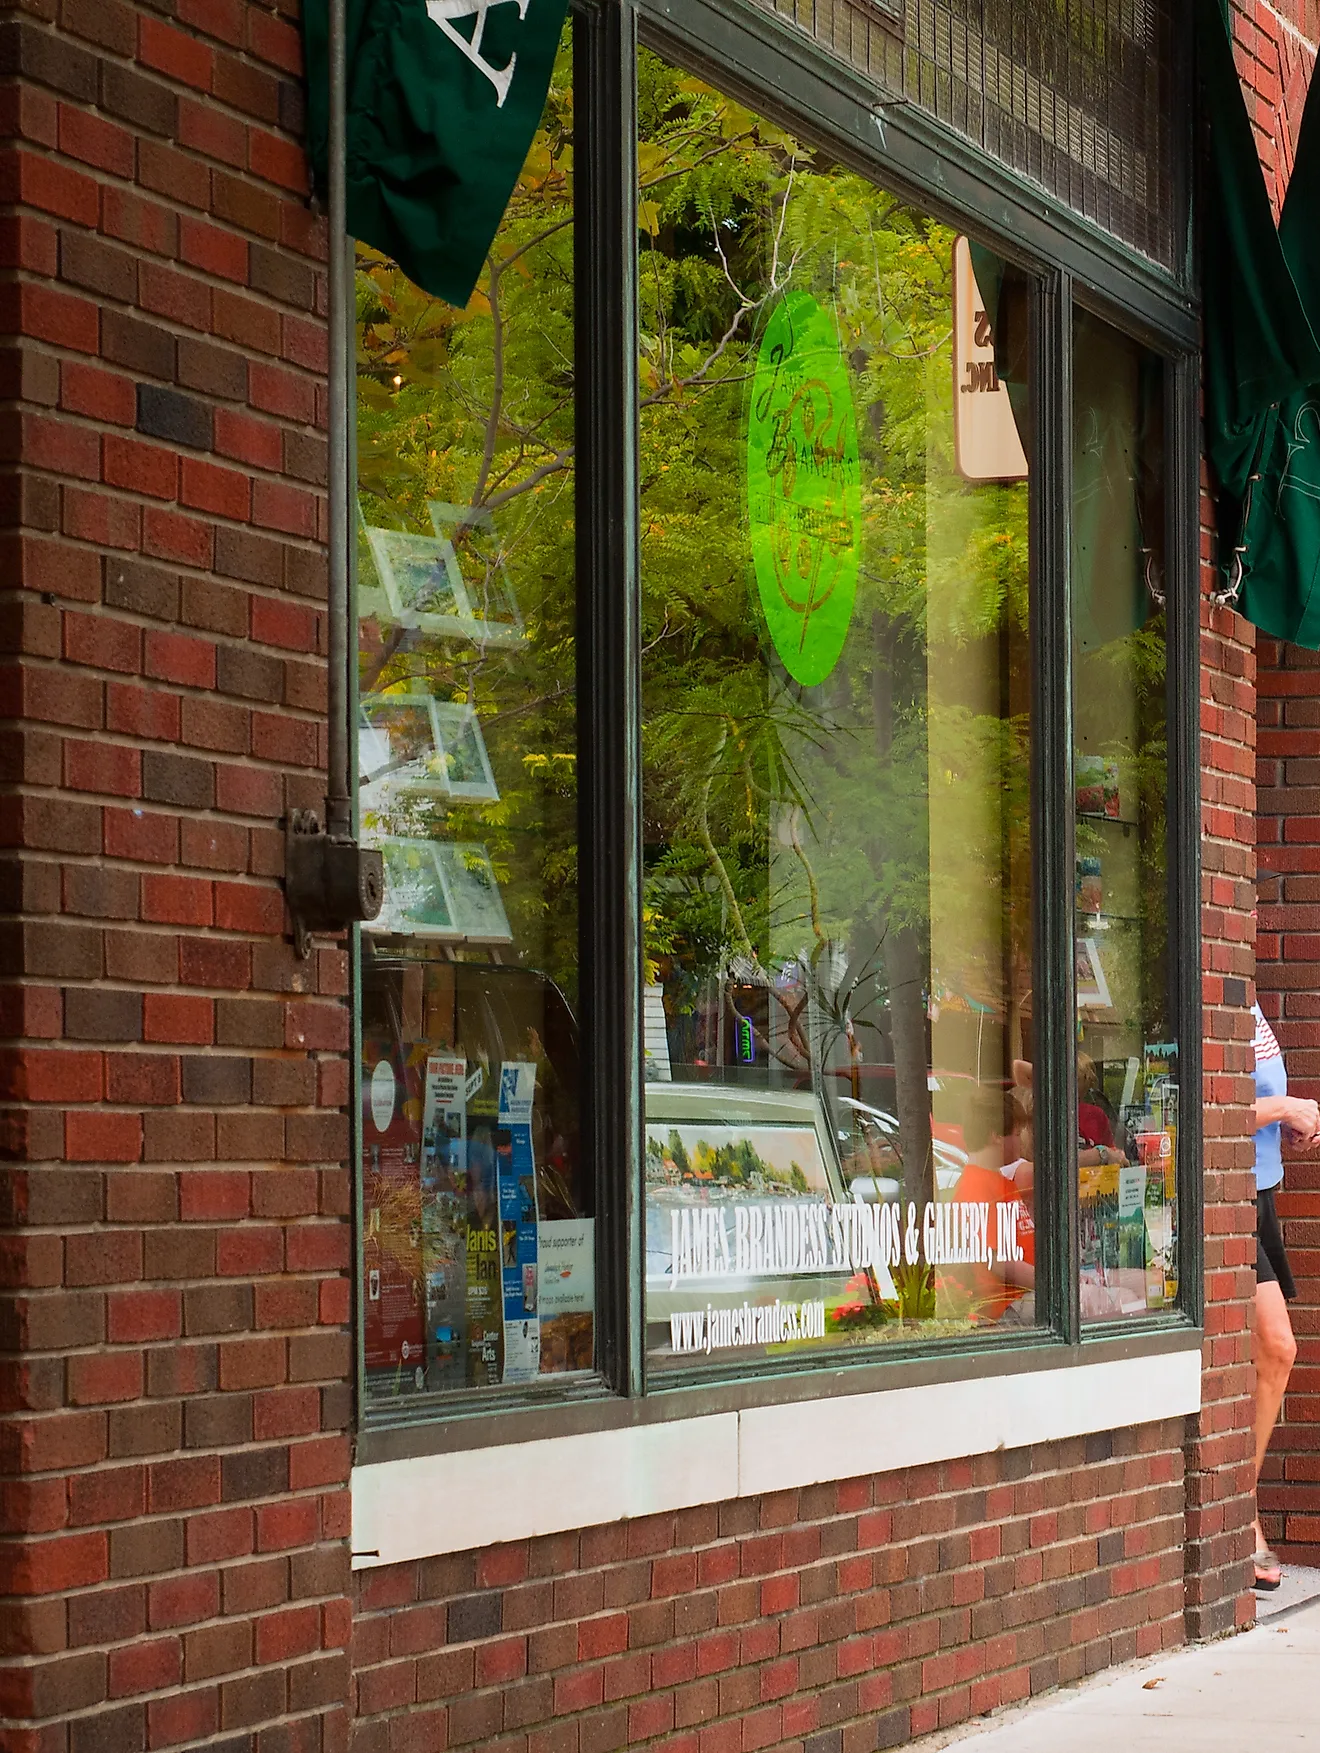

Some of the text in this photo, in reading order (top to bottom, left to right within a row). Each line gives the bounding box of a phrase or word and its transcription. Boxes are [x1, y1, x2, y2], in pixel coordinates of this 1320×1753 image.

[669, 1207, 730, 1291] JAMES
[734, 1203, 828, 1274] BRANDESS
[905, 1201, 919, 1265] &
[923, 1201, 993, 1271] GALLERY,
[996, 1201, 1025, 1263] INC.
[670, 1299, 825, 1355] www.jamesbrandess.com
